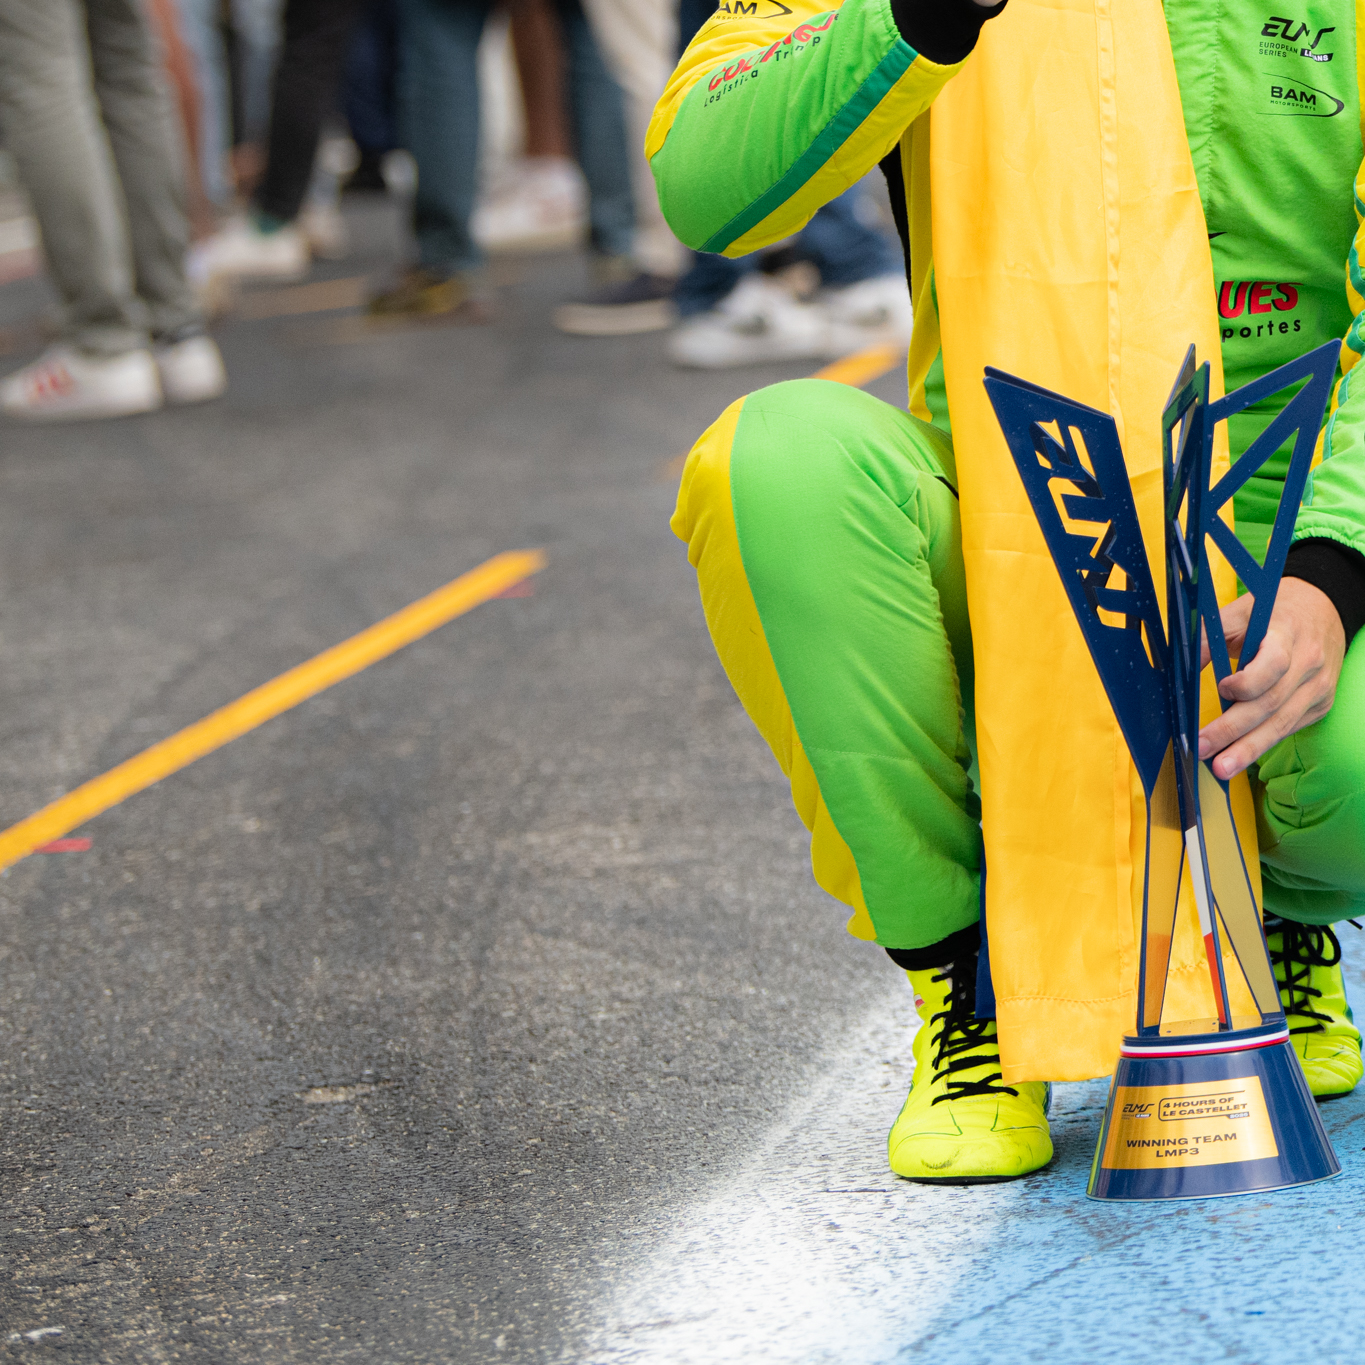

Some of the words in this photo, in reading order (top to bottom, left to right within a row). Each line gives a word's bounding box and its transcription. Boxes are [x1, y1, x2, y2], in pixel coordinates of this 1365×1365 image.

[1259, 42, 1298, 54] EUROPEAN
[1259, 49, 1287, 57] SERIES
[1271, 86, 1316, 105] BAM
[1270, 100, 1316, 111] MOTORSPORTS
[1123, 1104, 1155, 1113] ELMS
[1173, 1099, 1216, 1108] HOURS
[1178, 1103, 1247, 1115] CASTELLET
[1126, 1138, 1188, 1148] WINNING
[1192, 1133, 1237, 1144] TEAM
[1156, 1148, 1199, 1157] LMP3
